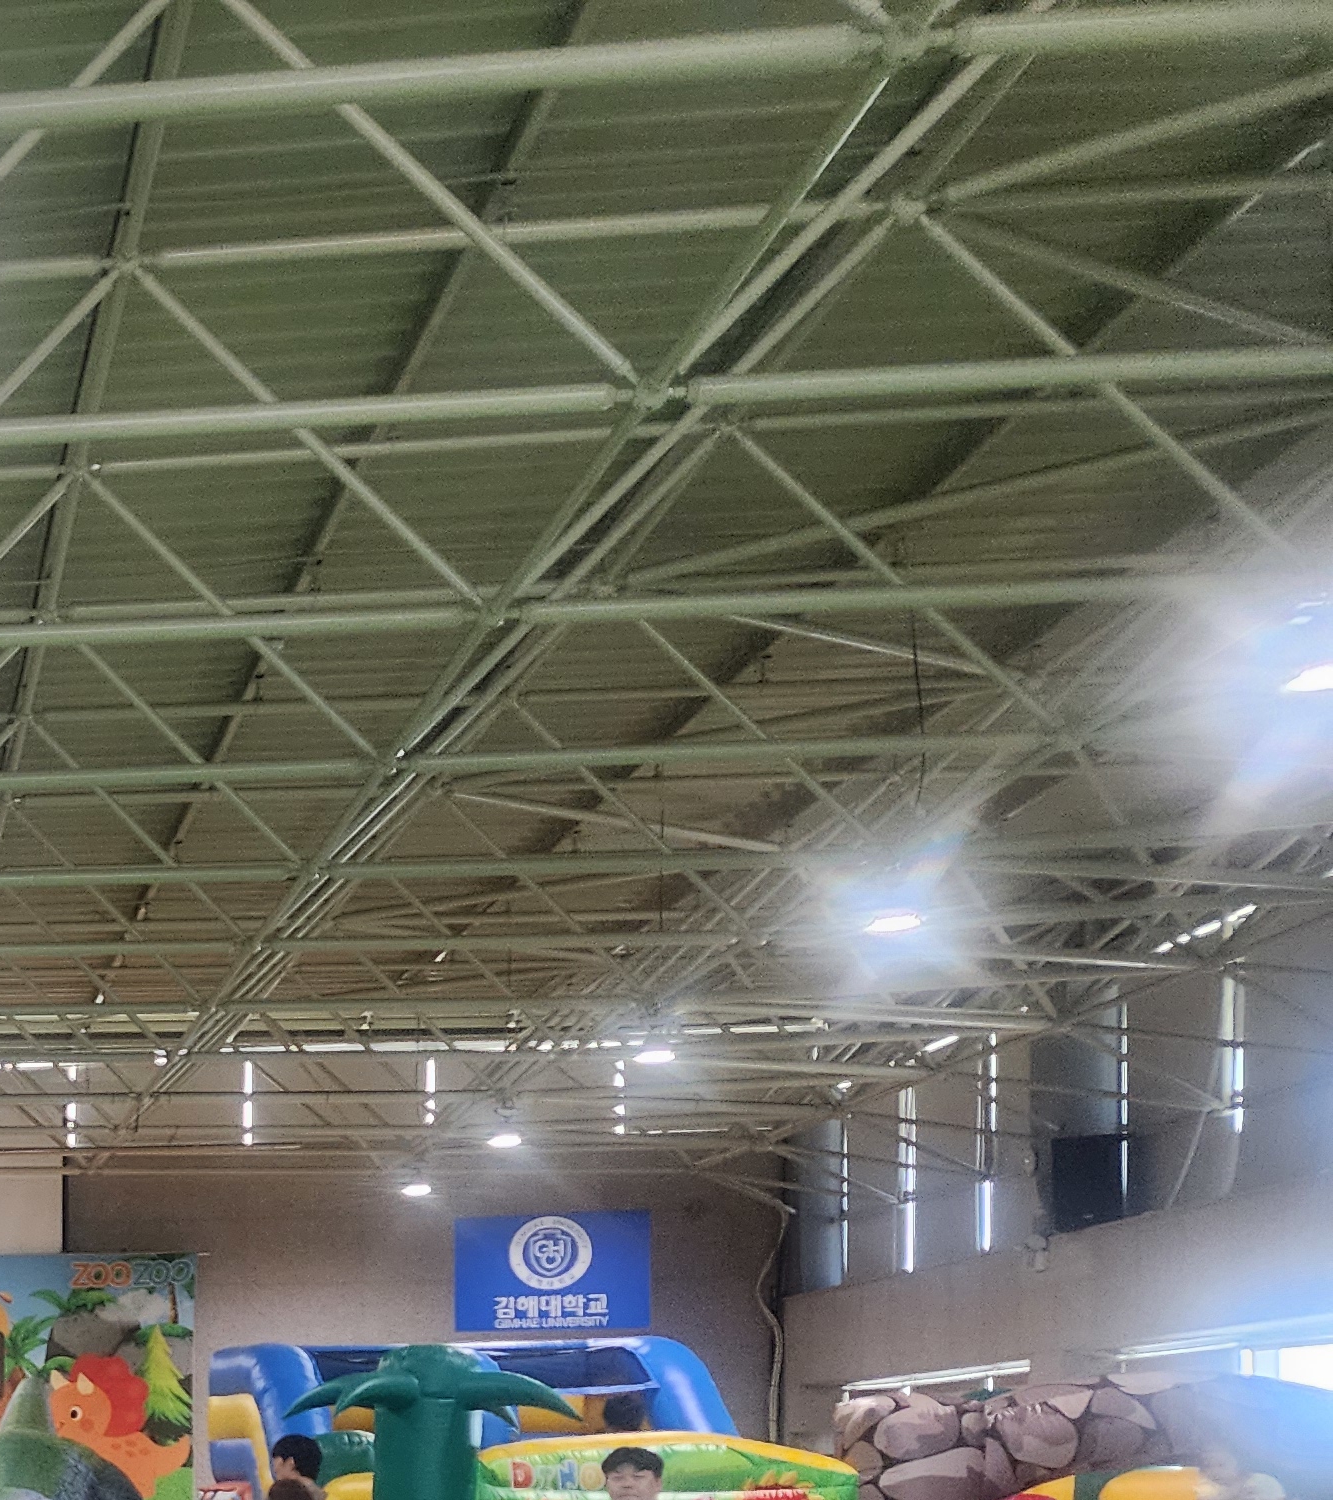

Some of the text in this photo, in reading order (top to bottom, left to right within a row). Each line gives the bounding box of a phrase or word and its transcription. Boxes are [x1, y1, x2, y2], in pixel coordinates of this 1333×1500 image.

[493, 1293, 609, 1318] 김해대학교
[494, 1315, 610, 1329] GIMHAE UNIVERSITY
